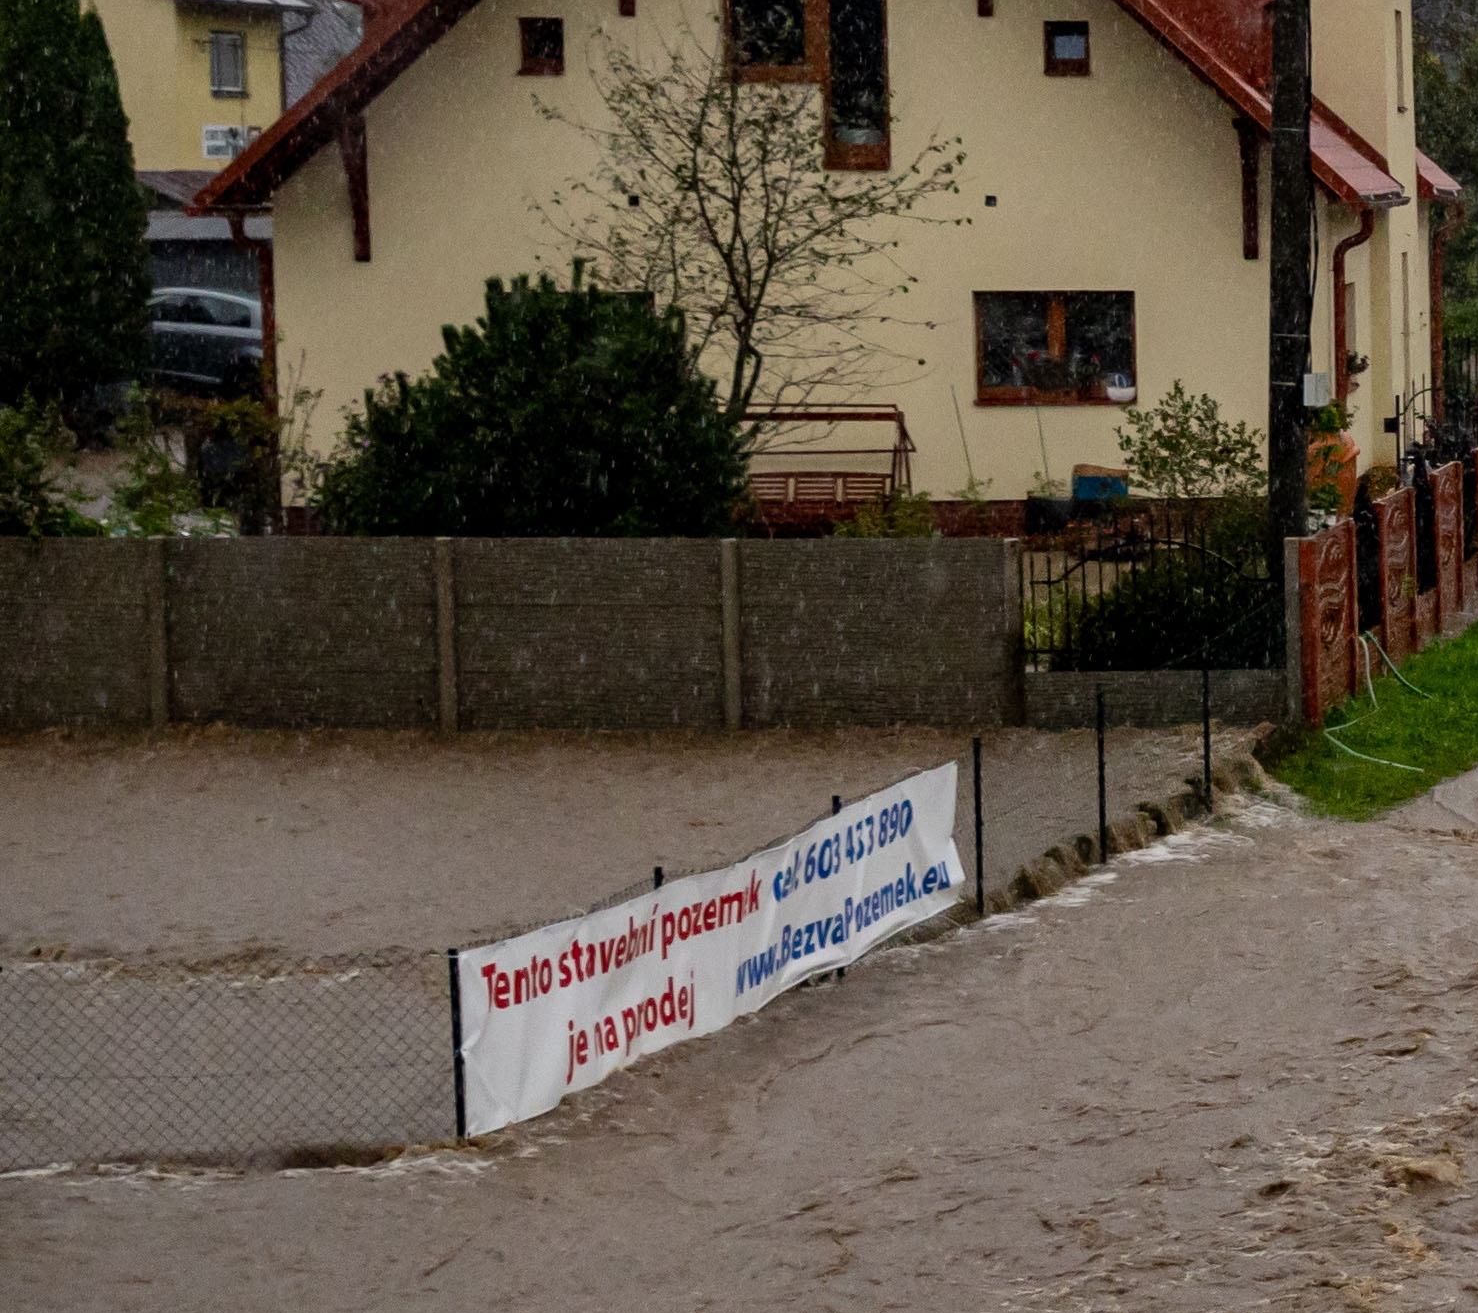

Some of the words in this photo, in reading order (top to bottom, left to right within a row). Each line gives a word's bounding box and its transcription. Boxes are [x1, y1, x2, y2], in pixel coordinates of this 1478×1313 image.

[803, 833, 841, 885] 603
[877, 798, 914, 848] 890
[481, 954, 553, 1012] Tento
[557, 903, 660, 989] stavební
[735, 861, 952, 997] www.BezvaPozemek.eu
[566, 1020, 589, 1086] je
[594, 1015, 619, 1056] na
[621, 970, 696, 1057] prodej
